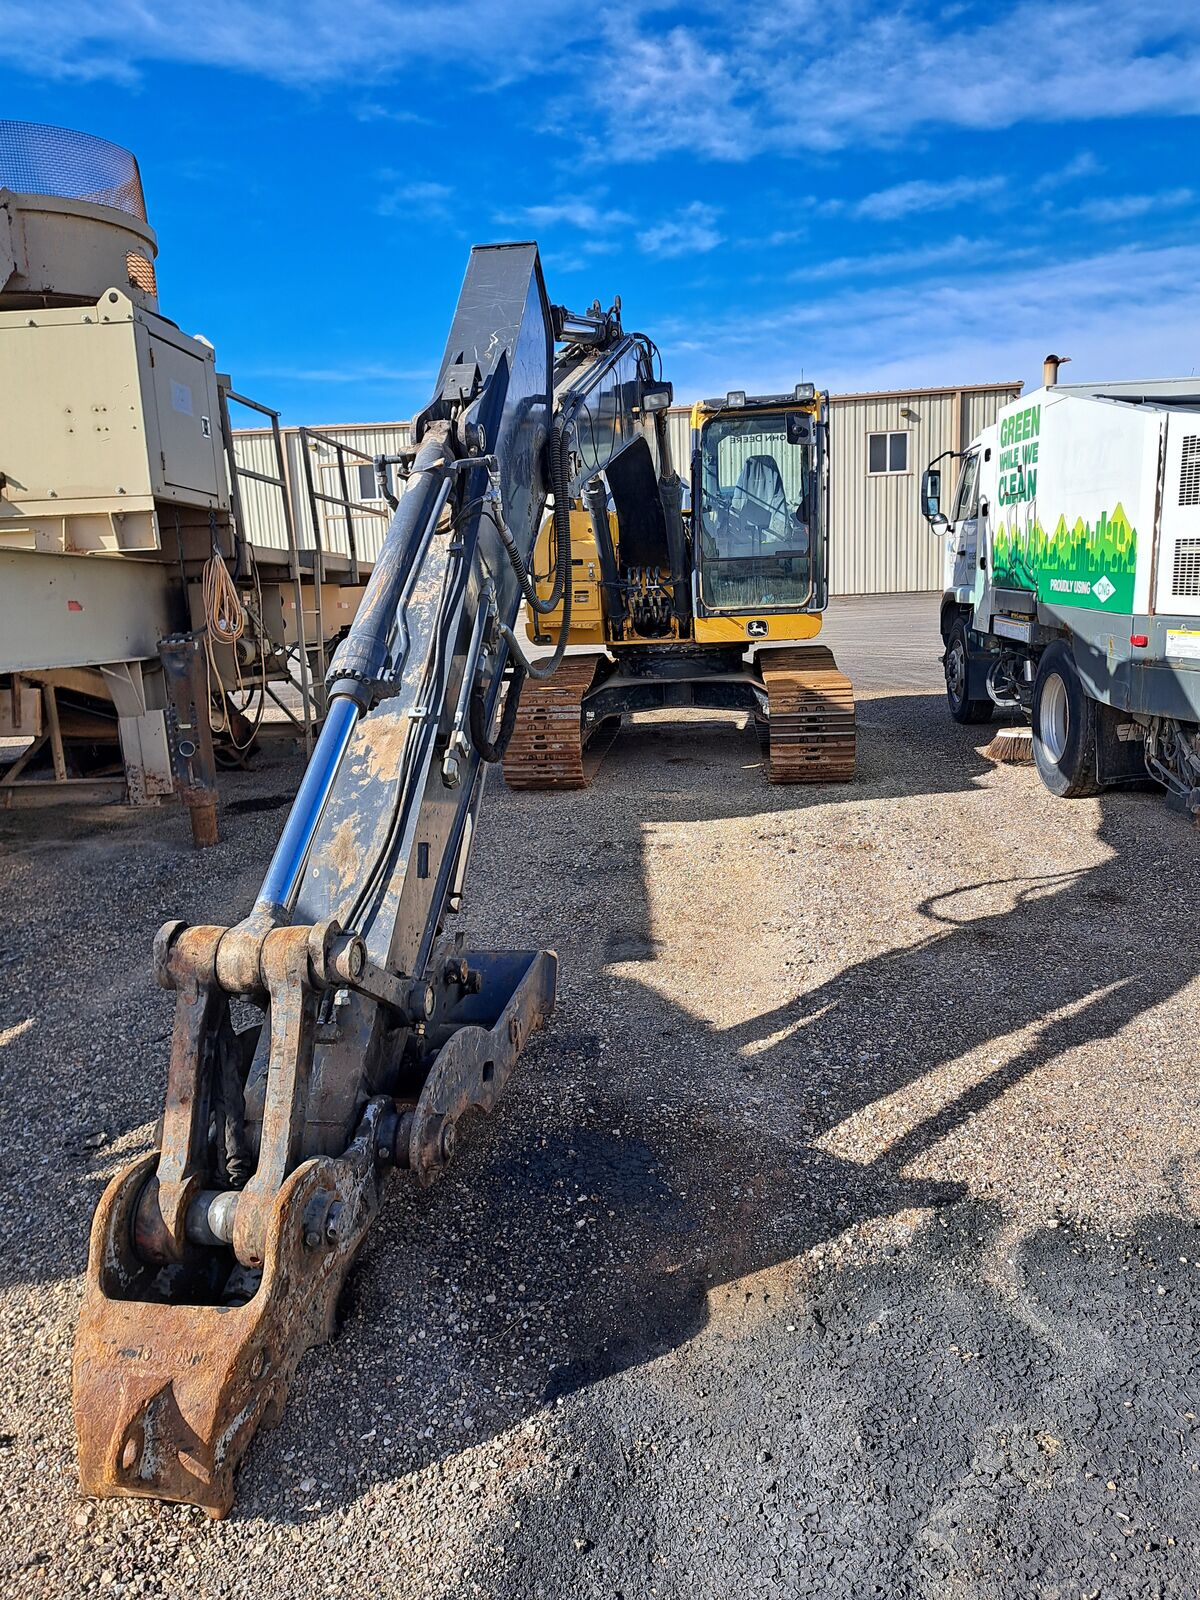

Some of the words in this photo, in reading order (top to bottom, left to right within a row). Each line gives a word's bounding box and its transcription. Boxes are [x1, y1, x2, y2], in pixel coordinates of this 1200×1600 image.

[1000, 404, 1041, 448] GREEN
[1000, 447, 1019, 472] WHILE
[1022, 442, 1039, 464] WE
[998, 469, 1037, 506] CLEAN
[1050, 579, 1073, 592] PROUDLY
[1074, 581, 1090, 594] USING
